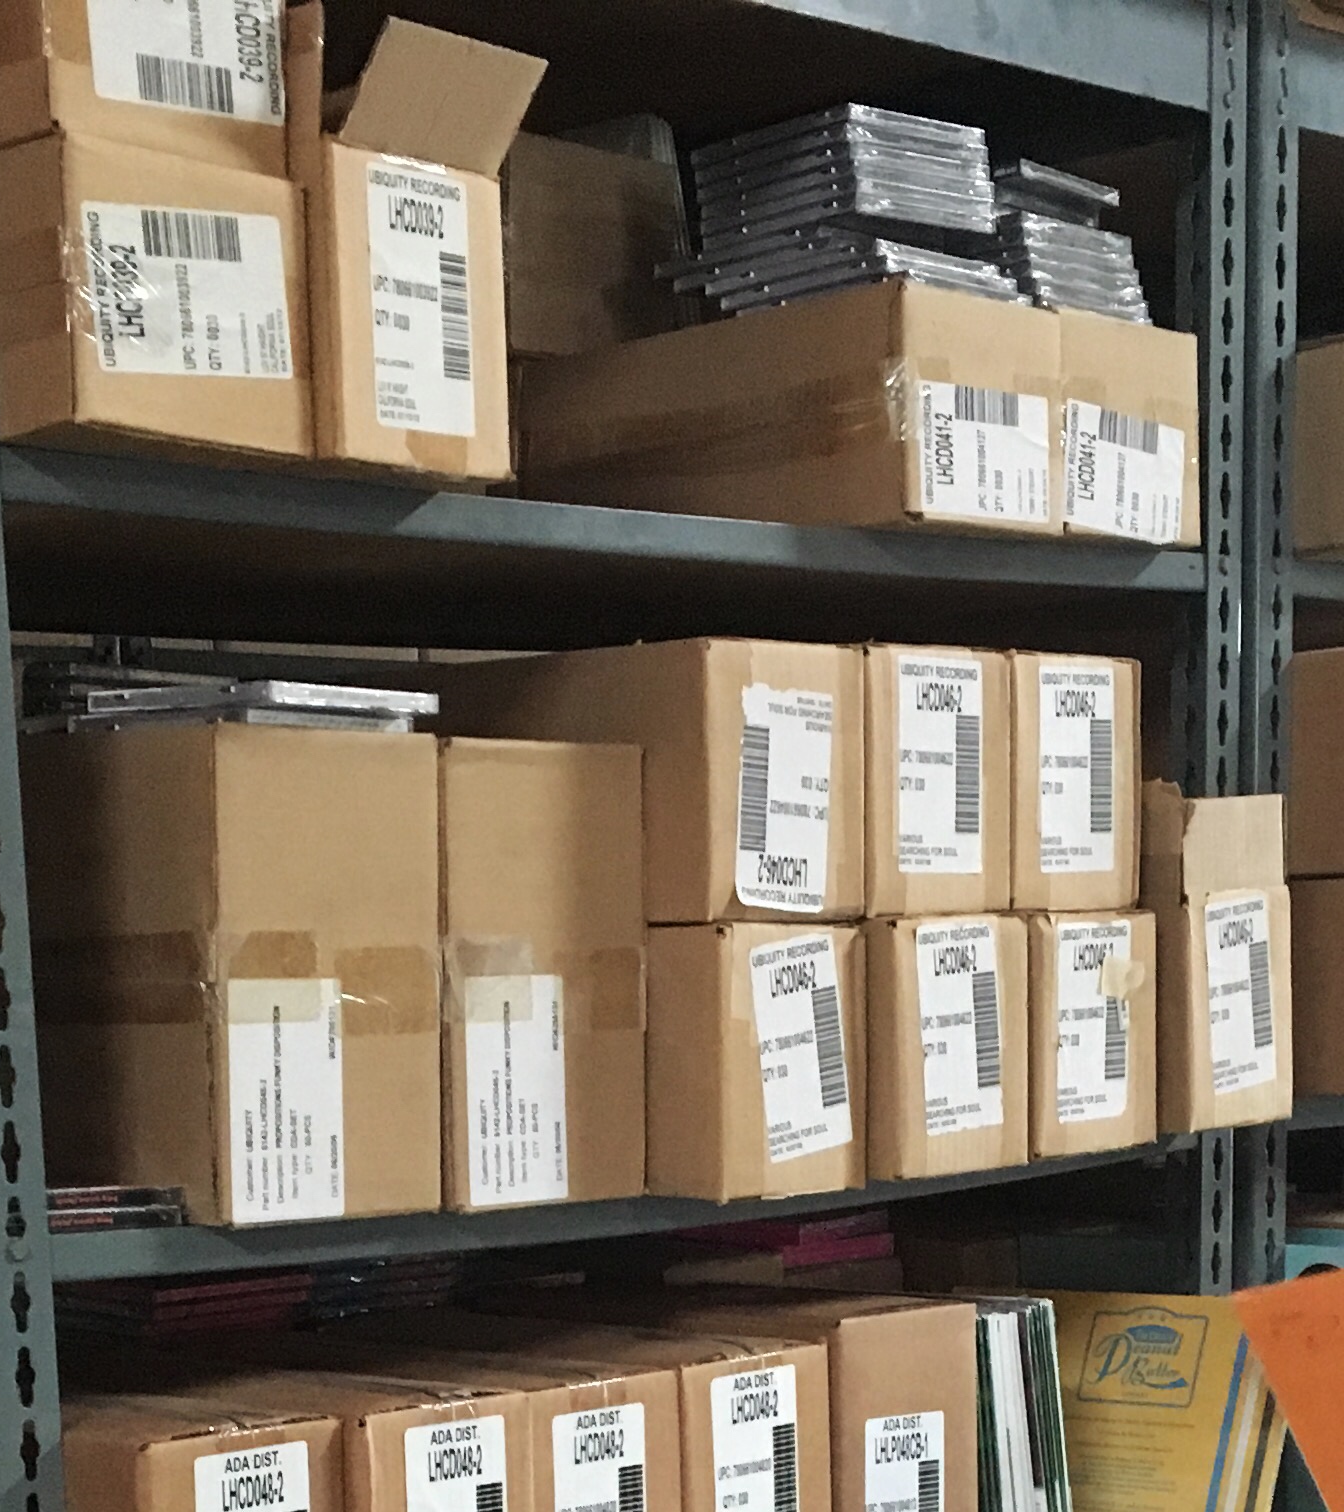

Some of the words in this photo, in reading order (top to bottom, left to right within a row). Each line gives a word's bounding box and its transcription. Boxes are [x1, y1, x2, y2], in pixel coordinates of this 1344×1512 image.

[234, 0, 264, 84] HCD039-2
[266, 33, 282, 116] RECORDING
[368, 170, 408, 188] UBIQUITY
[410, 179, 461, 201] RECORDING
[388, 195, 444, 239] LHCD039-2
[97, 301, 117, 367] UBIQUITY
[935, 413, 954, 486] LHCD041-2
[1077, 431, 1097, 501] LHCD041-2
[922, 457, 934, 505] UBIQUITY
[901, 663, 934, 677] UBIQUITY
[936, 666, 977, 680] RECORDING
[1072, 673, 1110, 686] RECORDING
[916, 682, 962, 712] LHCD046-2
[1054, 690, 1096, 718] LHCD046-2
[757, 854, 808, 888] LHCD046-2
[950, 926, 990, 942] RECORDING
[752, 949, 785, 967] UBIQUITY
[786, 939, 829, 958] RECORDING
[933, 944, 977, 977] LHCD046-2
[769, 960, 817, 998] LHCD046-2
[733, 1377, 753, 1391] ADA
[576, 1415, 597, 1430] ADA
[599, 1410, 623, 1426] DIST.
[731, 1390, 779, 1425] LHCD048-2
[430, 1429, 453, 1446] ADA
[455, 1425, 481, 1441] DIST.
[883, 1418, 900, 1431] ADA
[225, 1457, 250, 1474] ADA
[253, 1450, 282, 1470] DIST.
[427, 1444, 483, 1483] LHCD048-2
[574, 1429, 624, 1466] LHCD048-2
[221, 1471, 284, 1512] LHCD048-2
